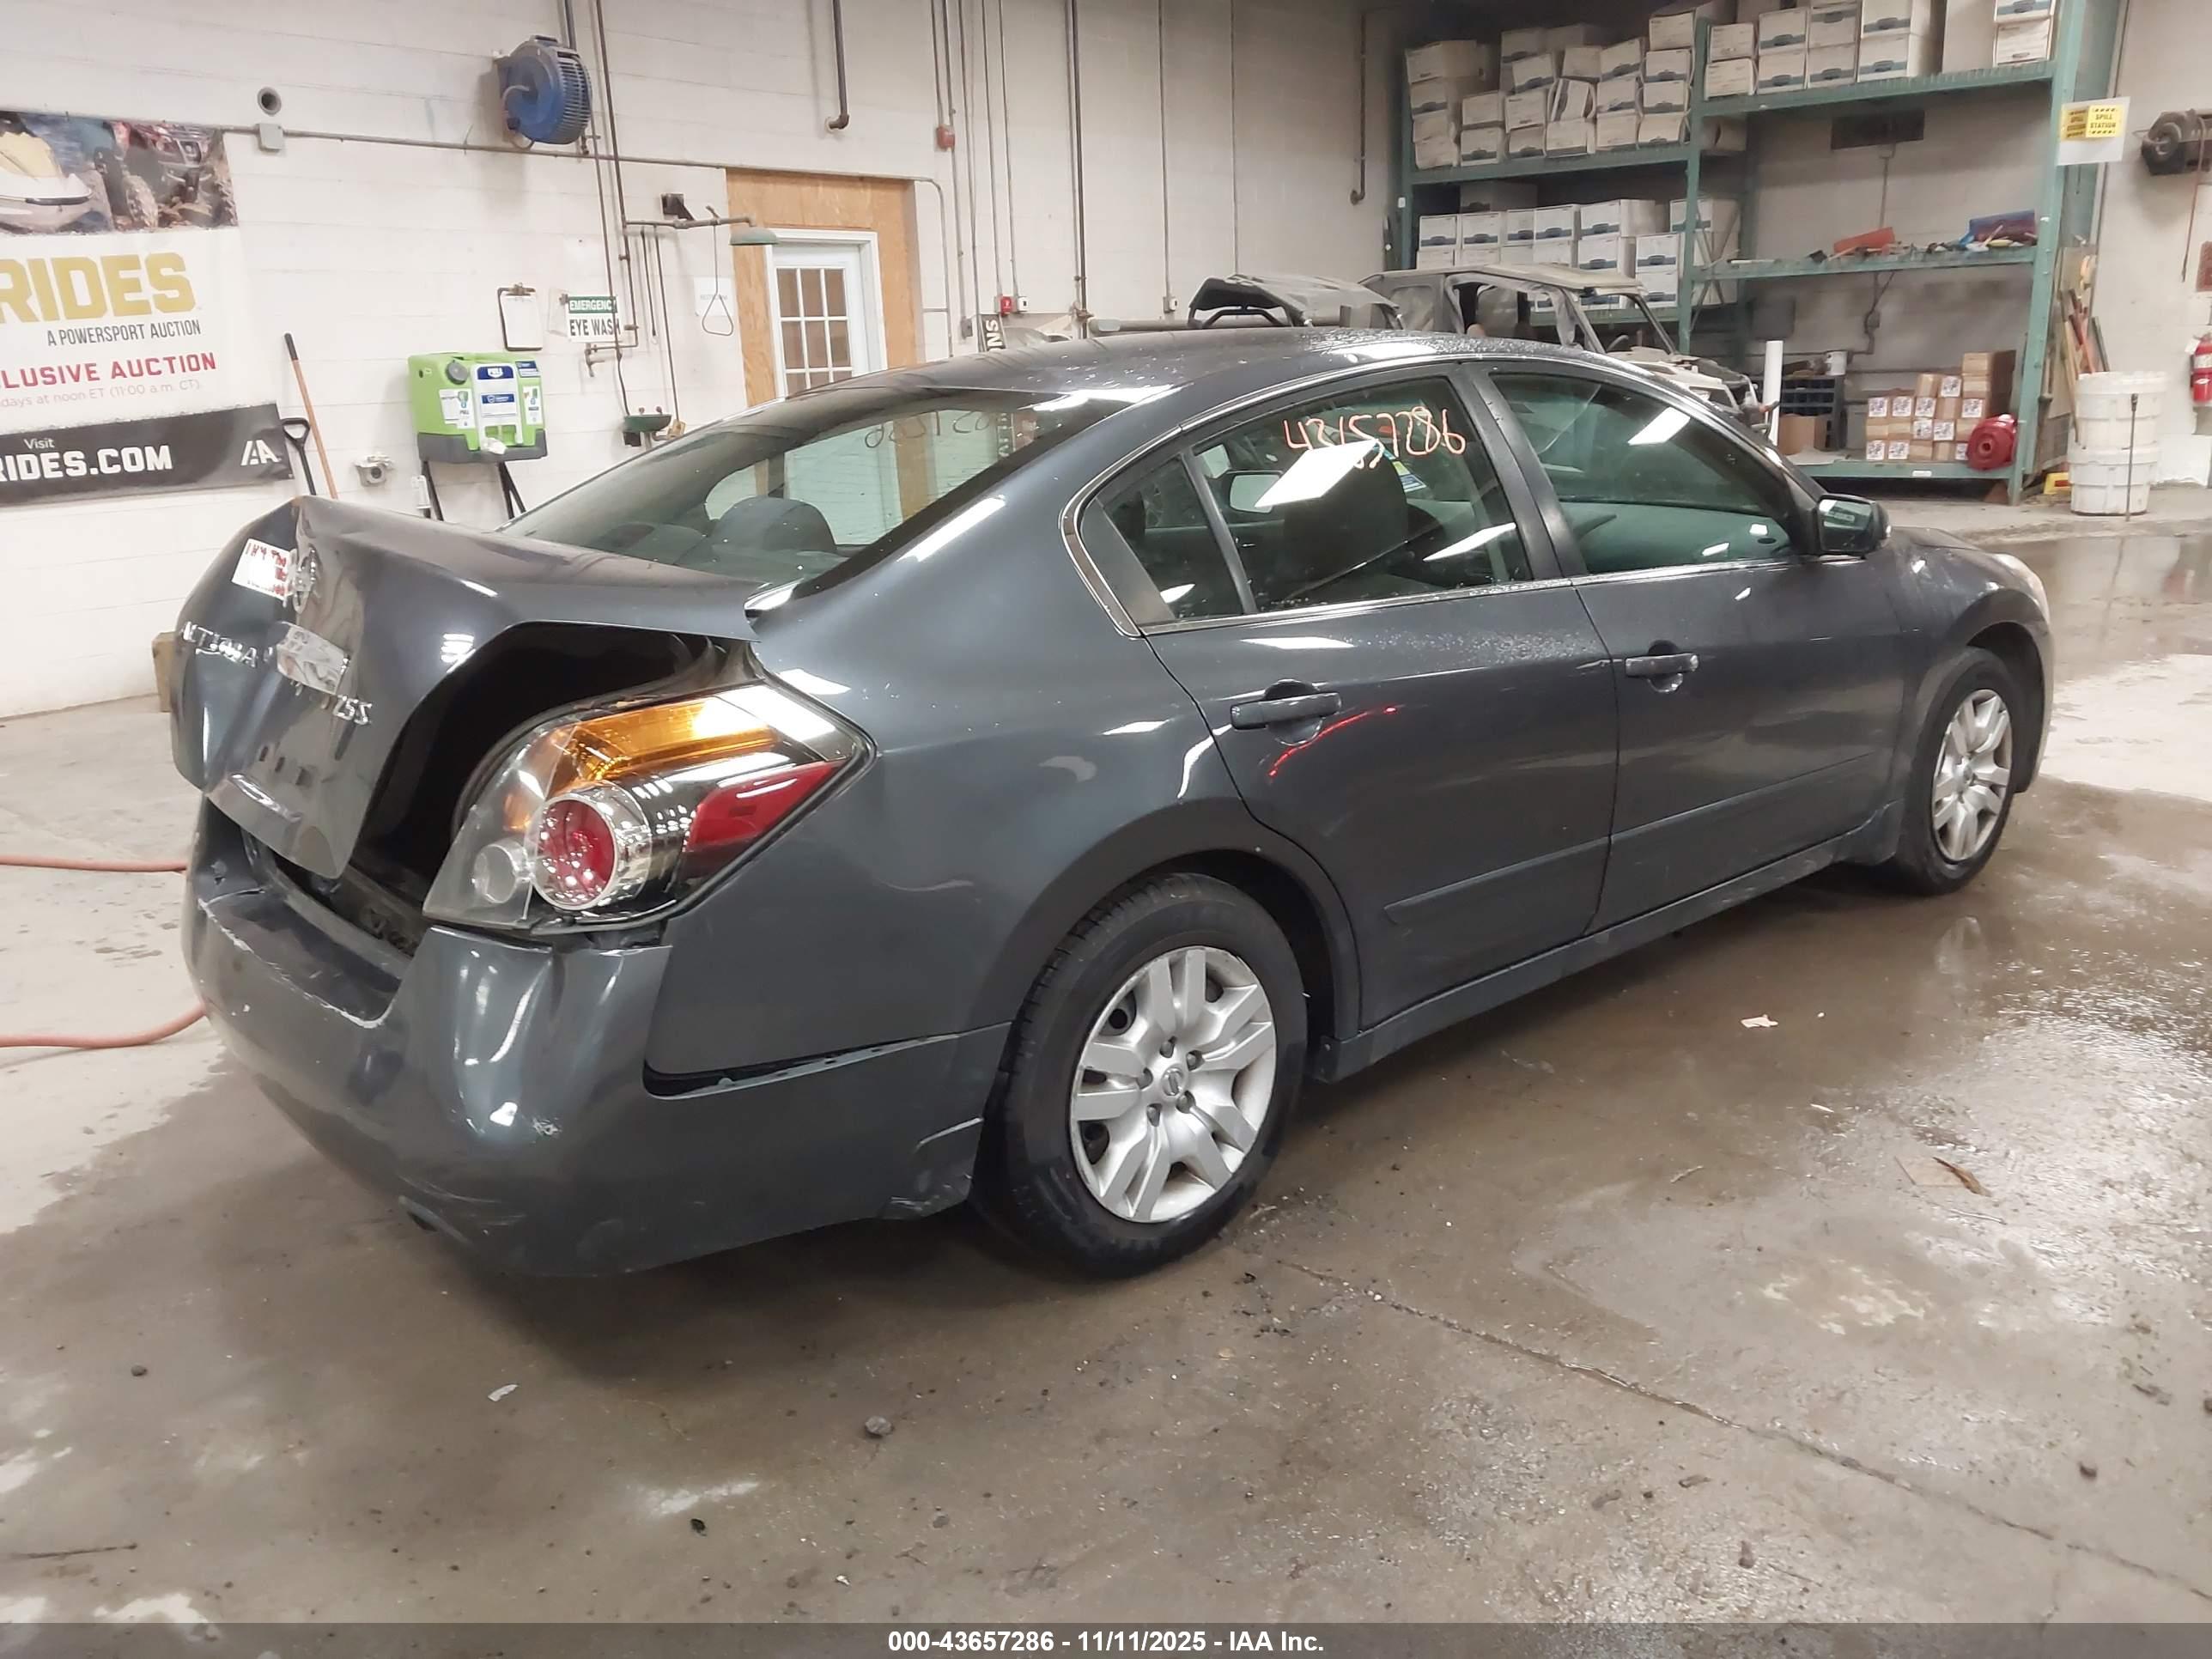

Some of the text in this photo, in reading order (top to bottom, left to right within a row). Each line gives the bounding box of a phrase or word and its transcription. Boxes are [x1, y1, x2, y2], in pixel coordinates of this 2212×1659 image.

[0, 252, 196, 324] RIDES
[47, 319, 202, 346] A POWERSPORT AUCTION
[569, 318, 622, 337] EYE WASH
[986, 319, 1003, 352] NS
[1, 352, 217, 389] LUSIVE AUCTION
[36, 394, 50, 405] at
[53, 392, 87, 403] noon
[88, 387, 105, 399] ET
[23, 437, 56, 450] Visit
